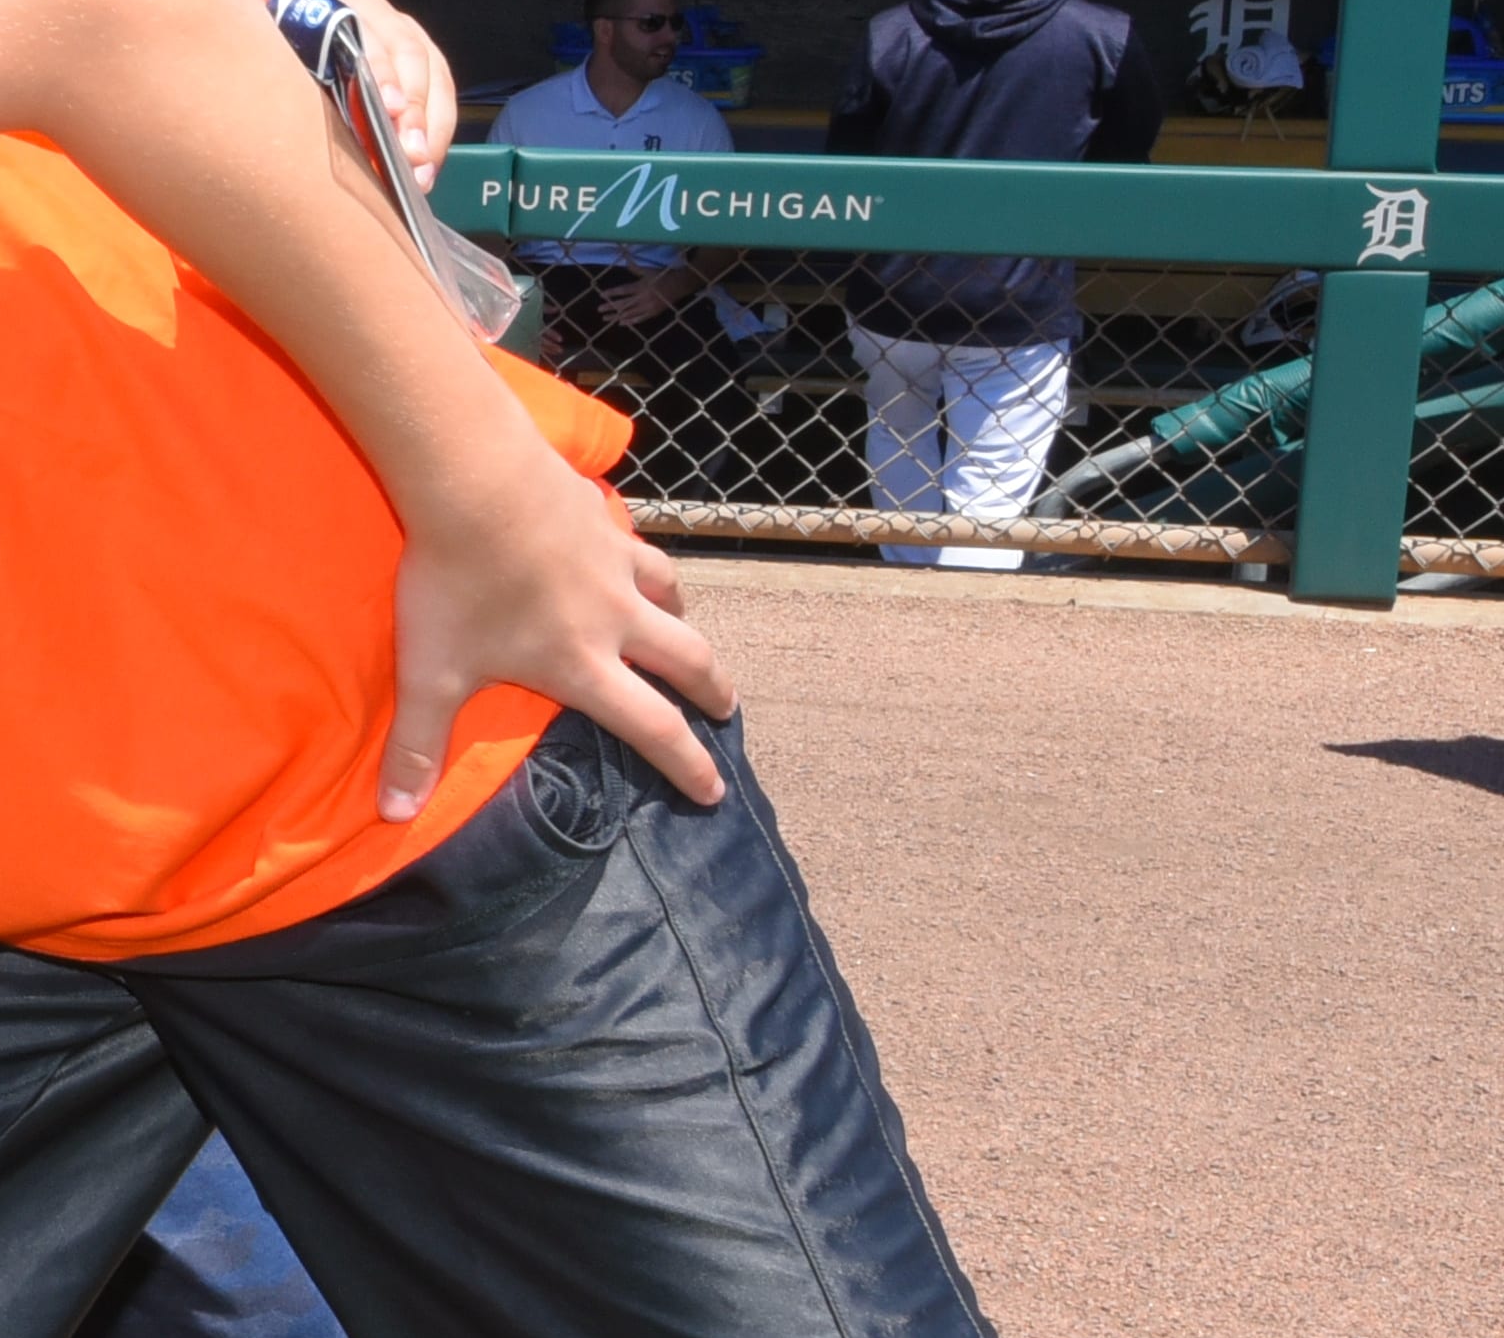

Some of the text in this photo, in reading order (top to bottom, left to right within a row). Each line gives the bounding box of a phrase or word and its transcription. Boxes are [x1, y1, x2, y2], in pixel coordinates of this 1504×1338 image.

[481, 162, 873, 239] PURE MICHIGAN
[1357, 181, 1430, 267] D
